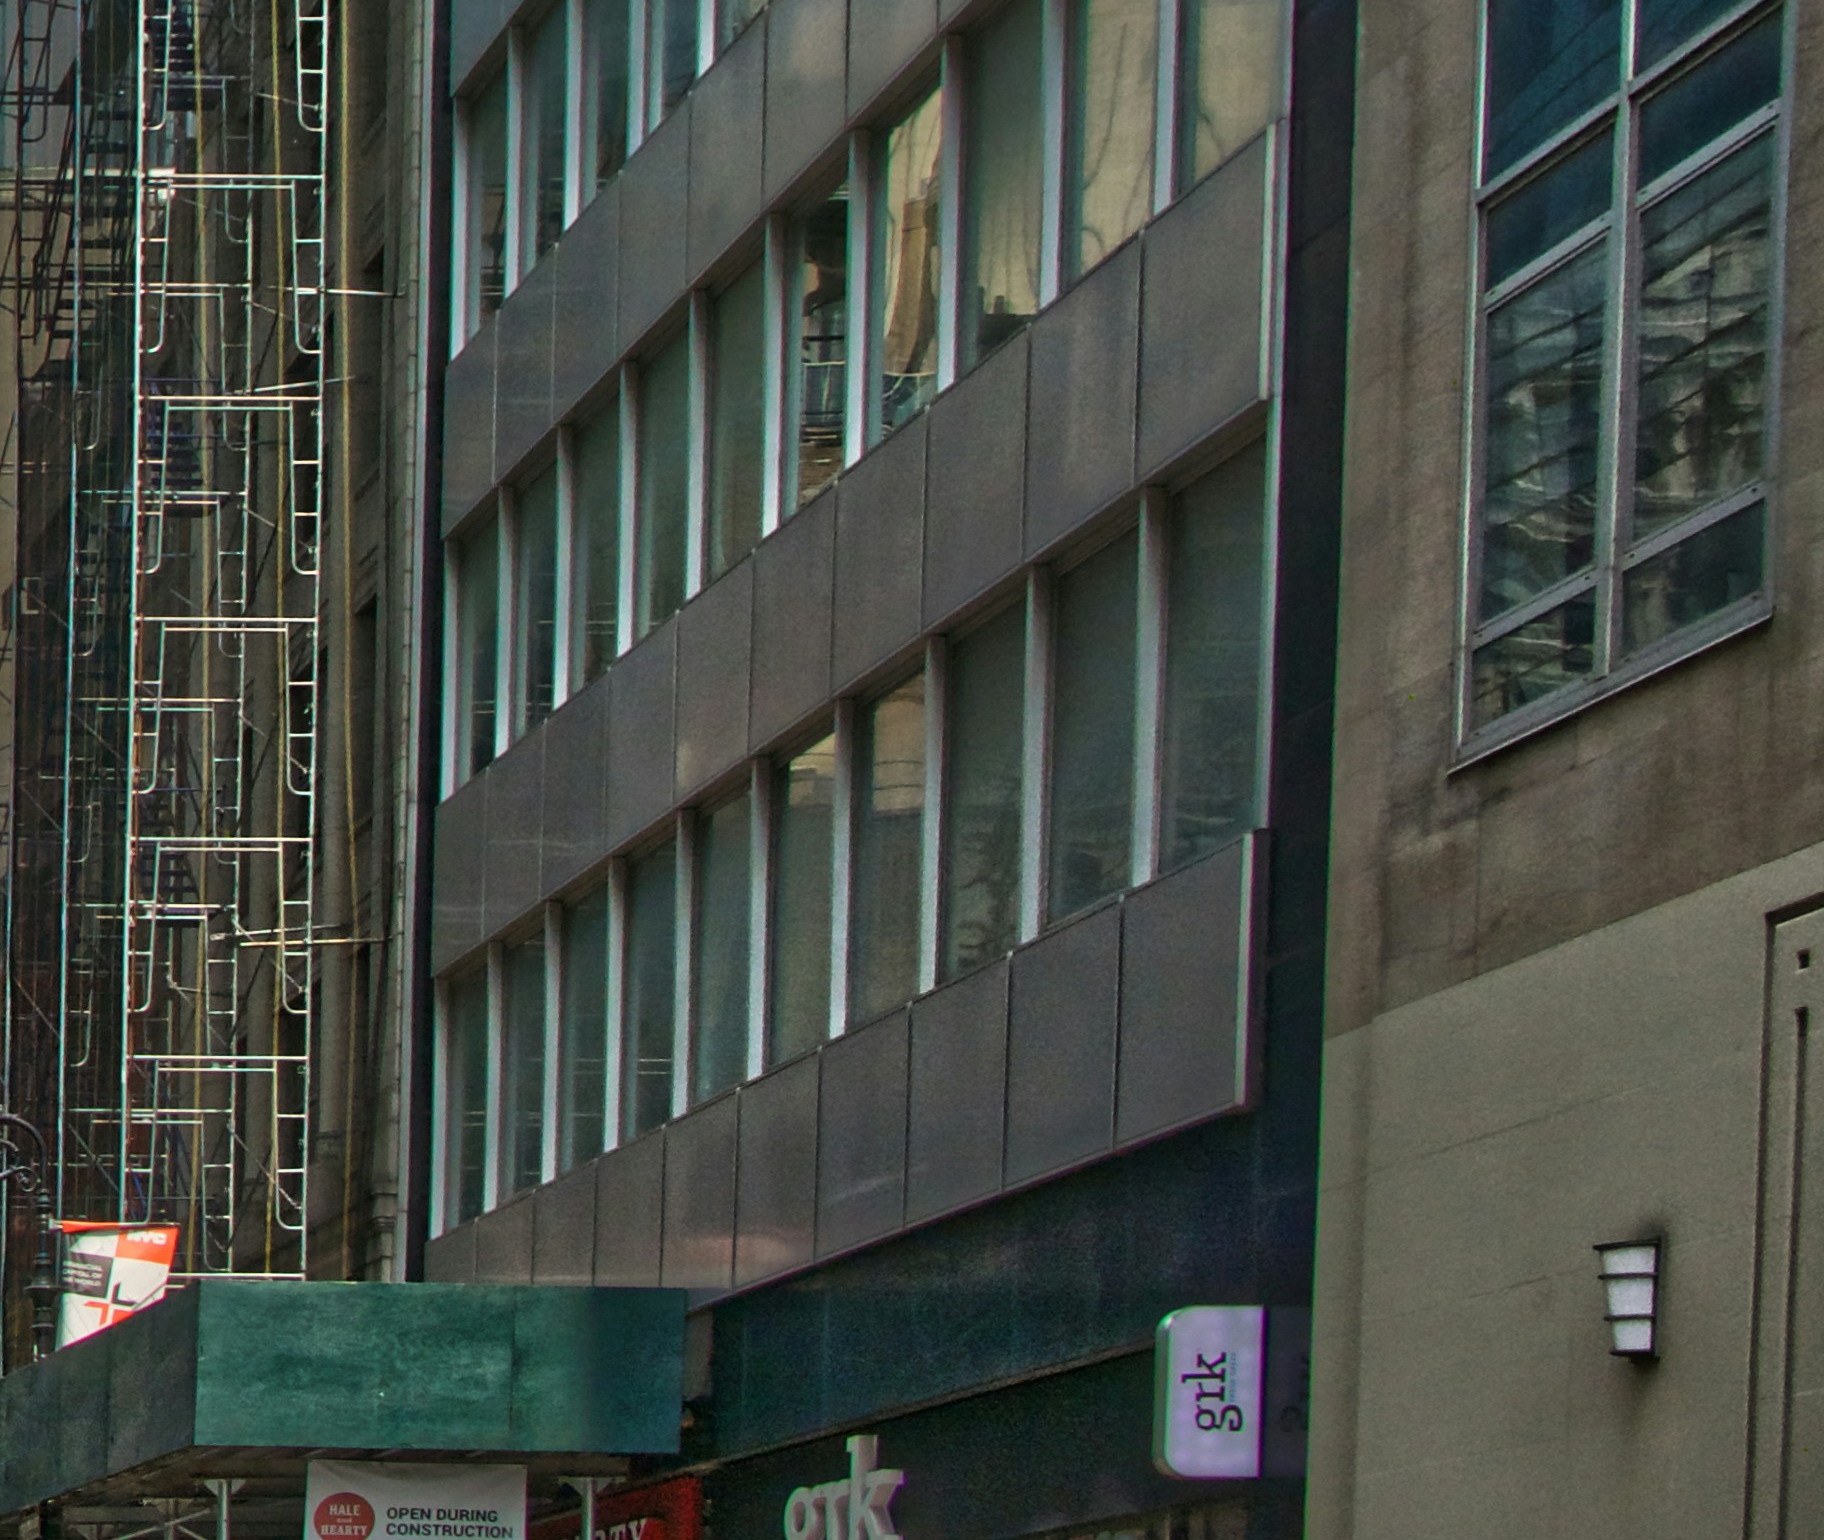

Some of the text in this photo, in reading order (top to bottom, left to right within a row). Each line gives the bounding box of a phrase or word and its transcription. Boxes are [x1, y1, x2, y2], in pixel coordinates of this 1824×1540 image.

[1181, 1351, 1243, 1432] grk
[329, 1503, 361, 1517] HALE
[385, 1506, 499, 1523] OPEN DURING
[320, 1524, 367, 1536] HEARTY
[385, 1522, 514, 1539] CONSTRUCTION
